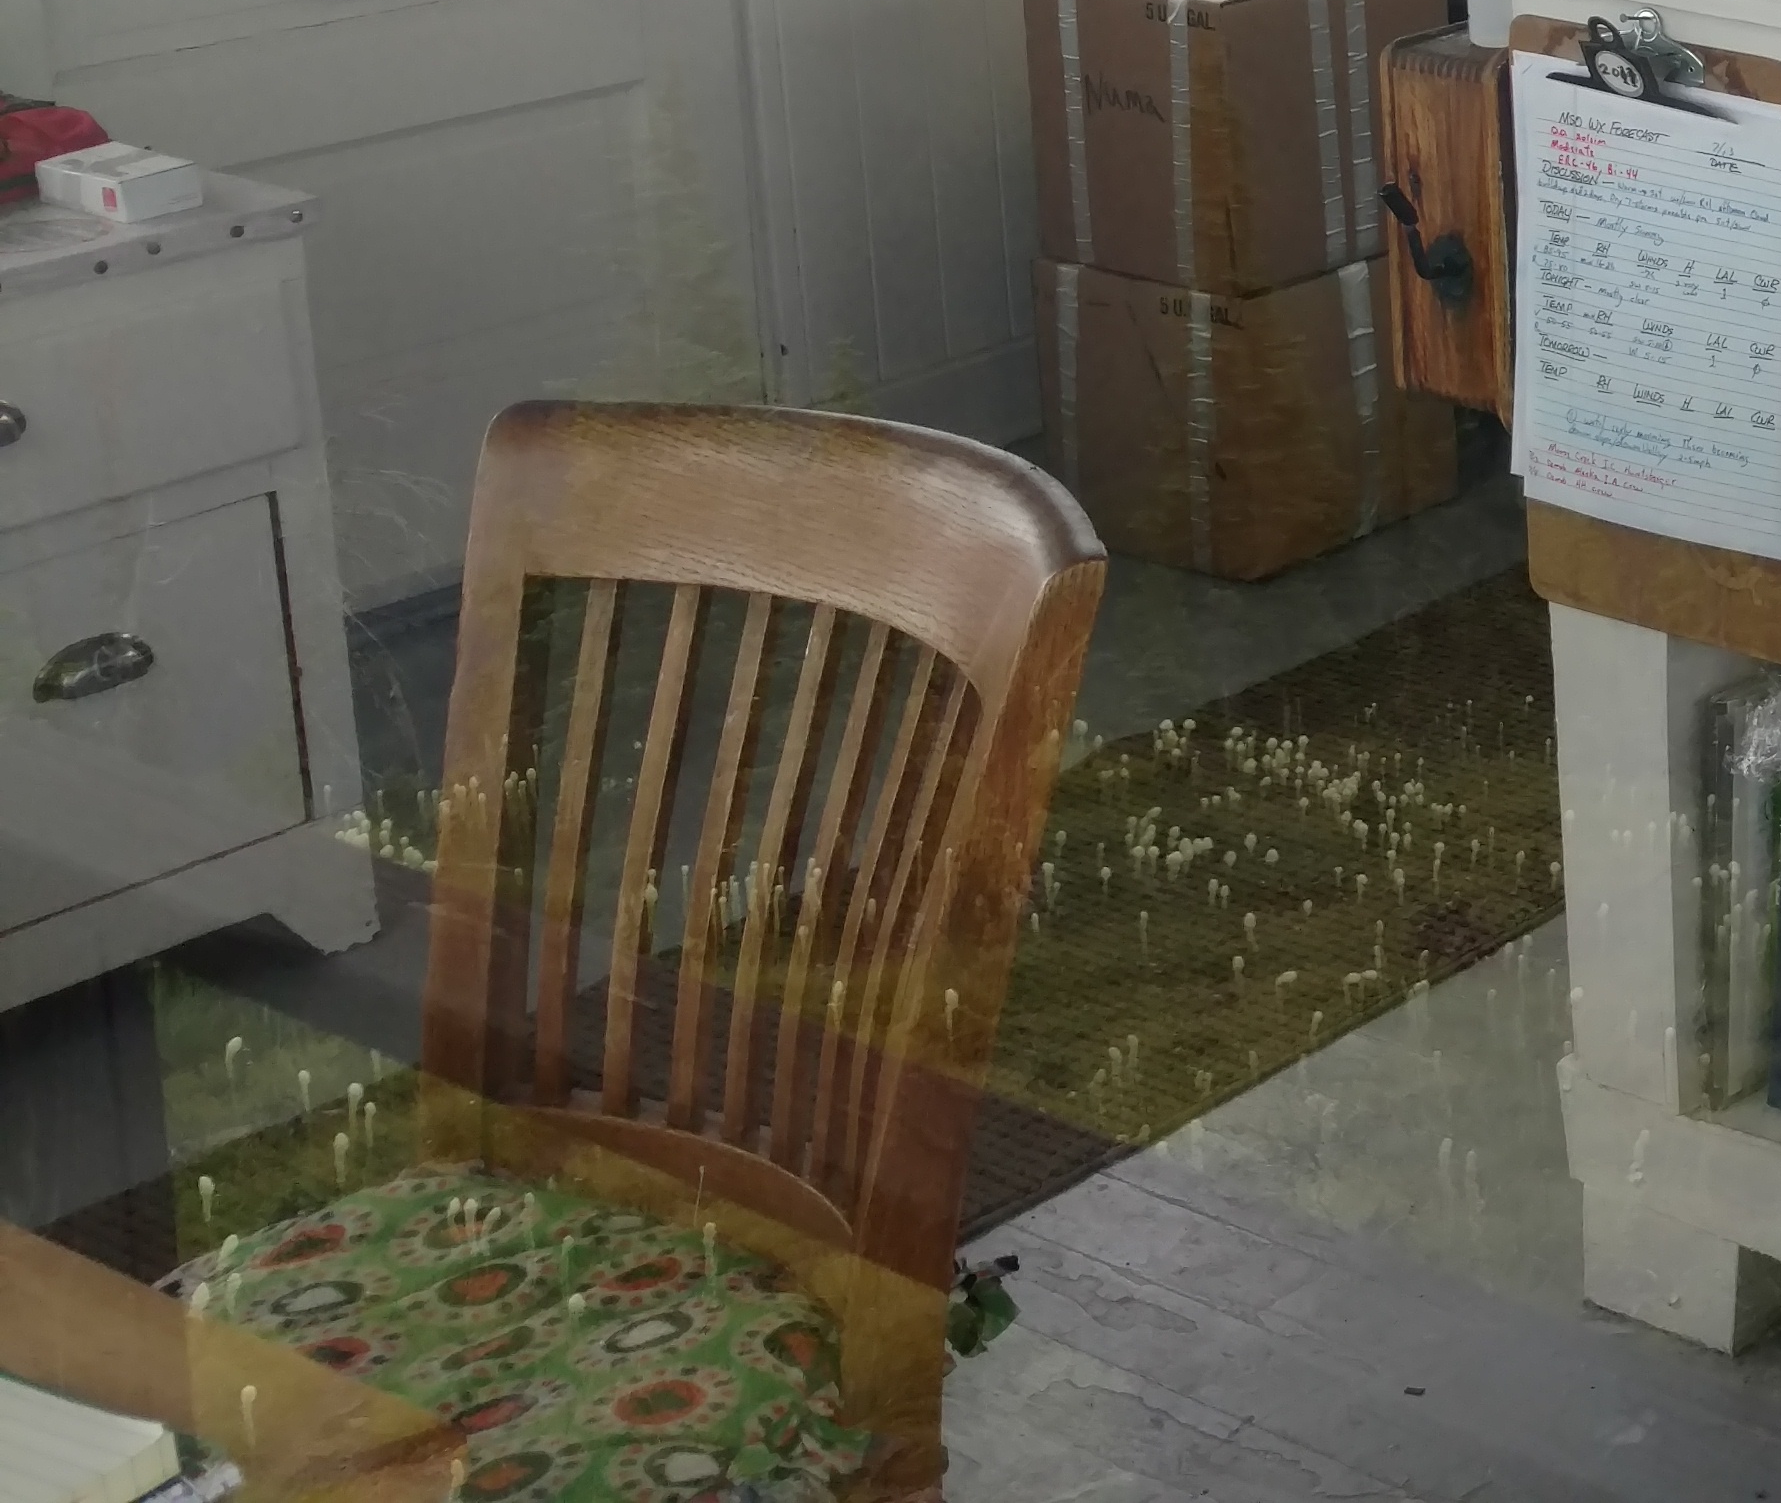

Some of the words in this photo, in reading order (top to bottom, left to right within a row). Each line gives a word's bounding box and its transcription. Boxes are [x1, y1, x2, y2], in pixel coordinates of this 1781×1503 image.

[1558, 112, 1582, 128] MSO
[1610, 121, 1671, 143] FORECAST
[1709, 157, 1742, 173] DATE
[1540, 200, 1573, 223] TODAY
[1549, 229, 1570, 246] TEMP
[1594, 242, 1611, 256] RH
[1540, 269, 1585, 290] TONIGHT
[1543, 295, 1573, 314] TEMP
[1540, 360, 1568, 377] TEMP
[1633, 383, 1665, 404] WINDS
